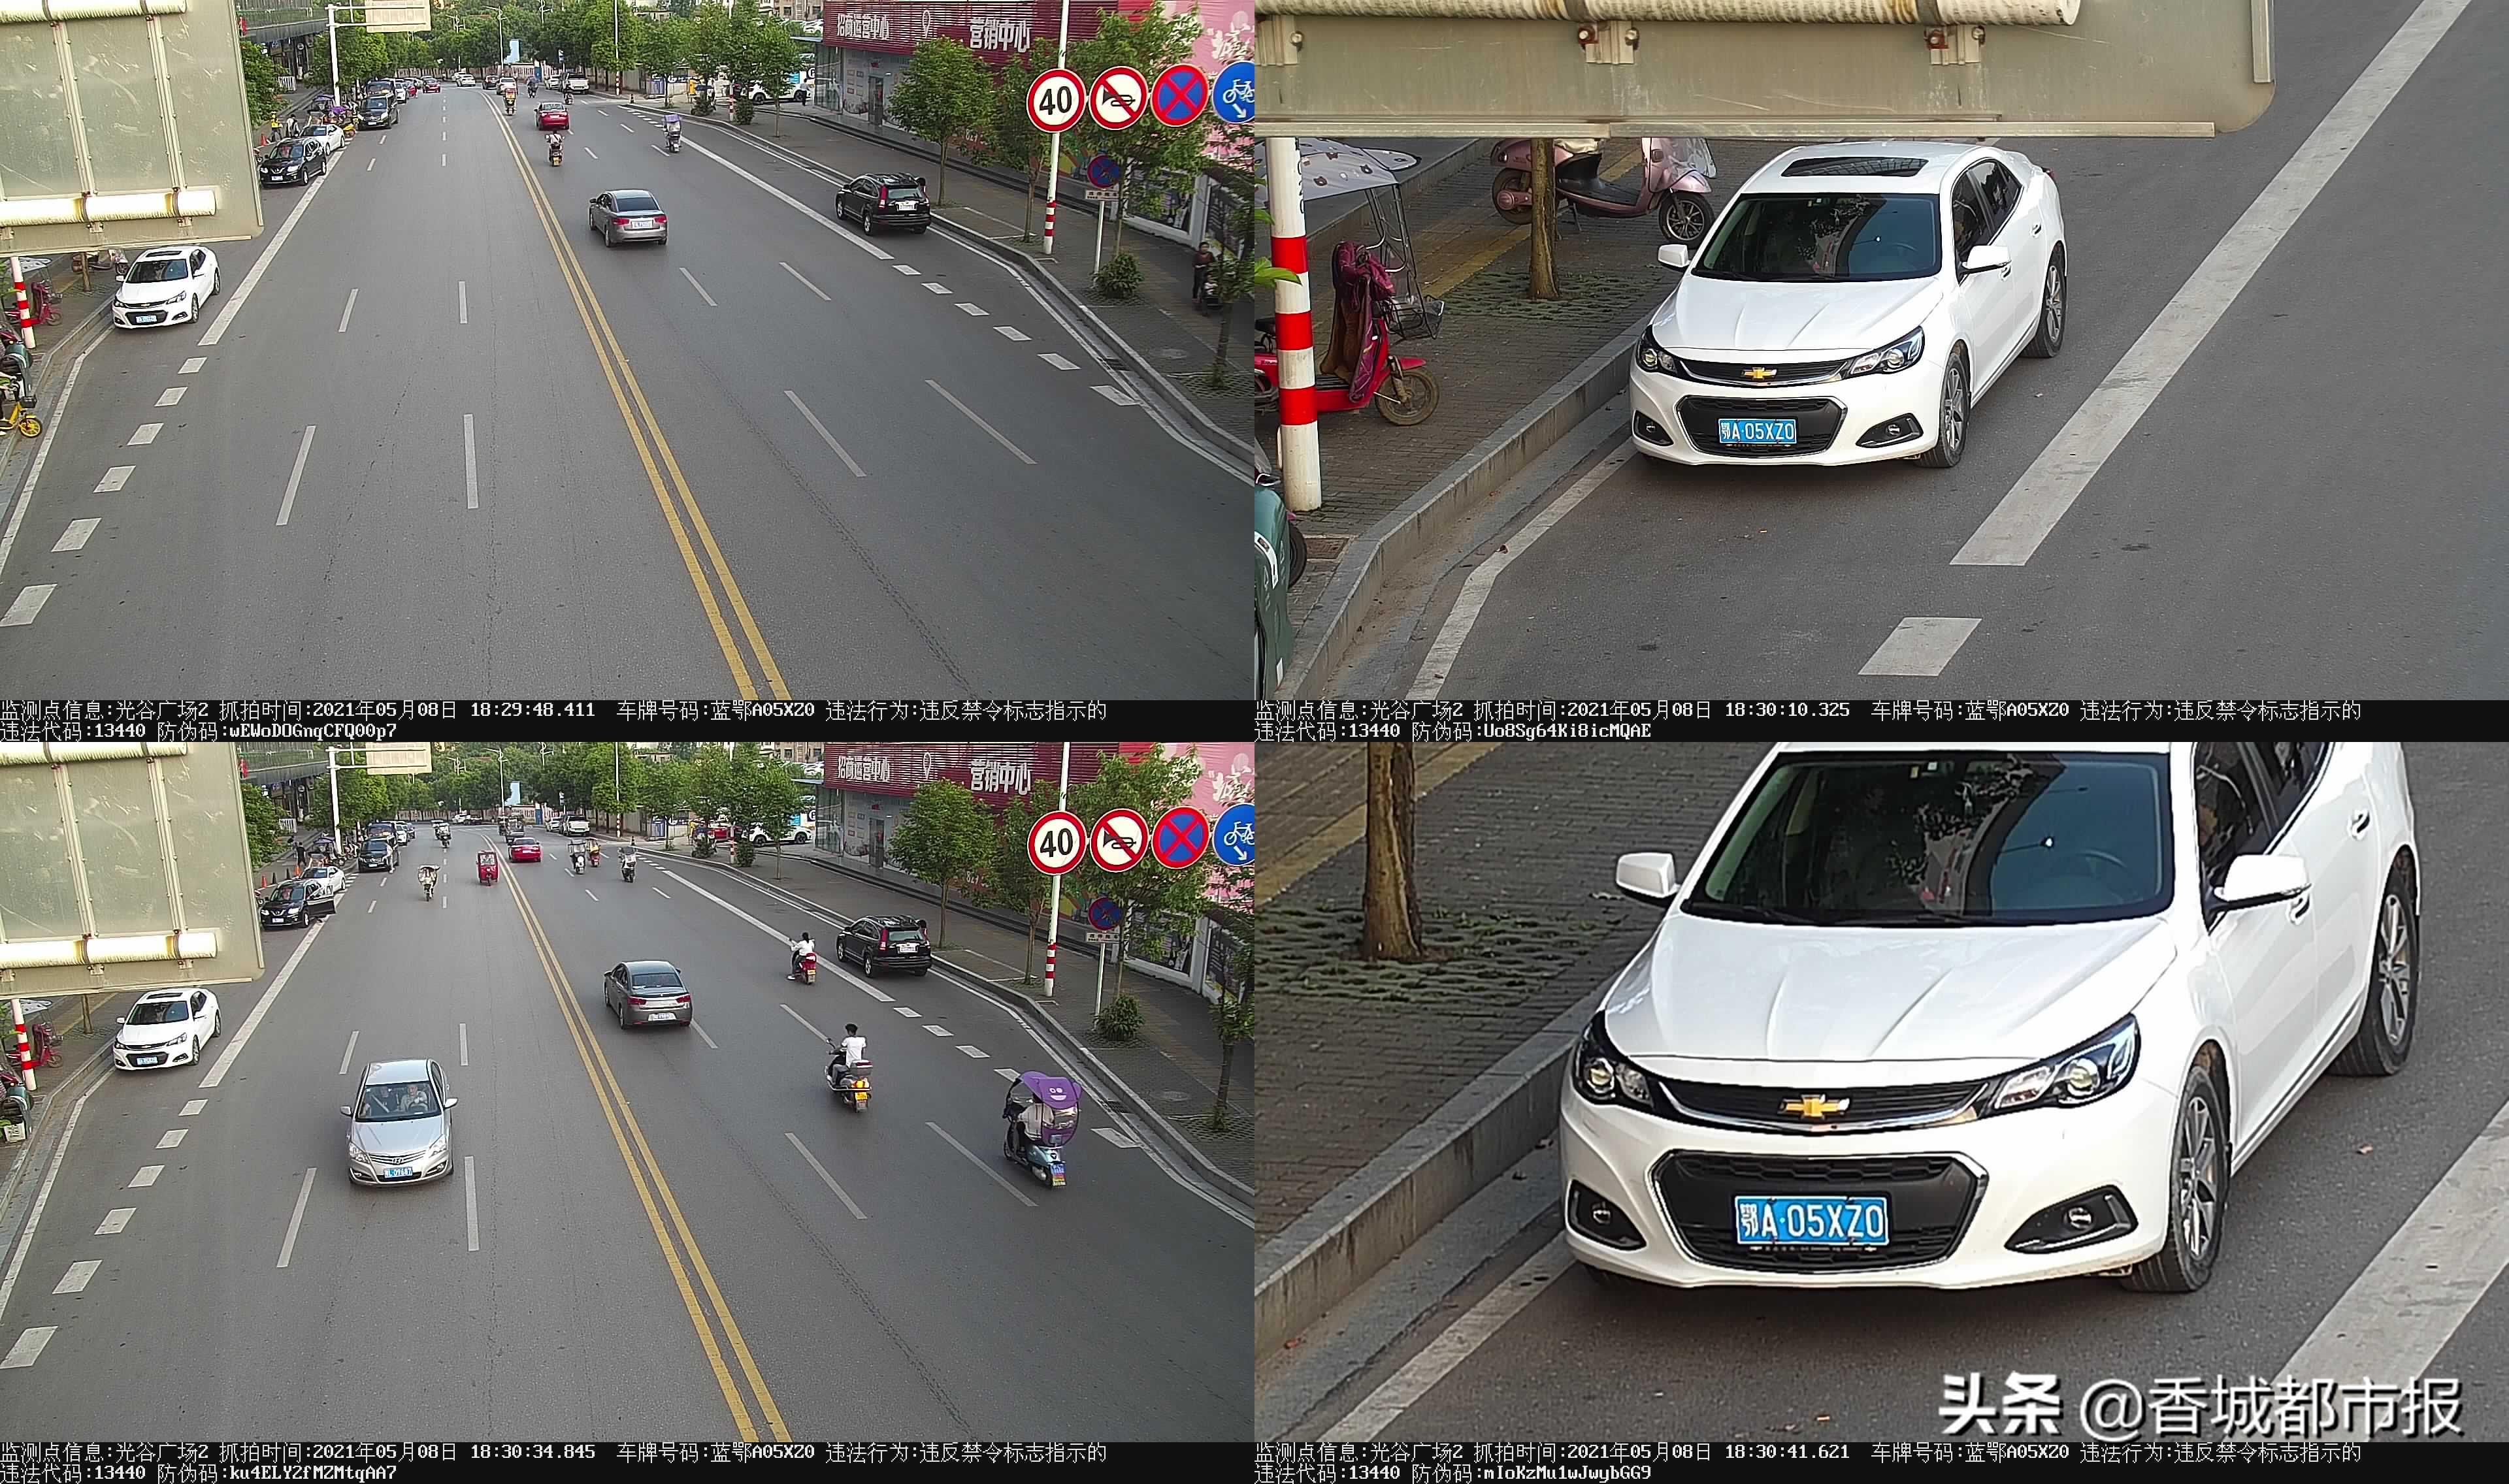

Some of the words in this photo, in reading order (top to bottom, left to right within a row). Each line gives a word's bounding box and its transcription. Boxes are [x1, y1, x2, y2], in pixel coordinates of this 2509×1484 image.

[970, 17, 1031, 53] 营销中心
[1039, 86, 1072, 116] 40
[971, 759, 1032, 796] 营销中心
[1040, 827, 1072, 858] 40
